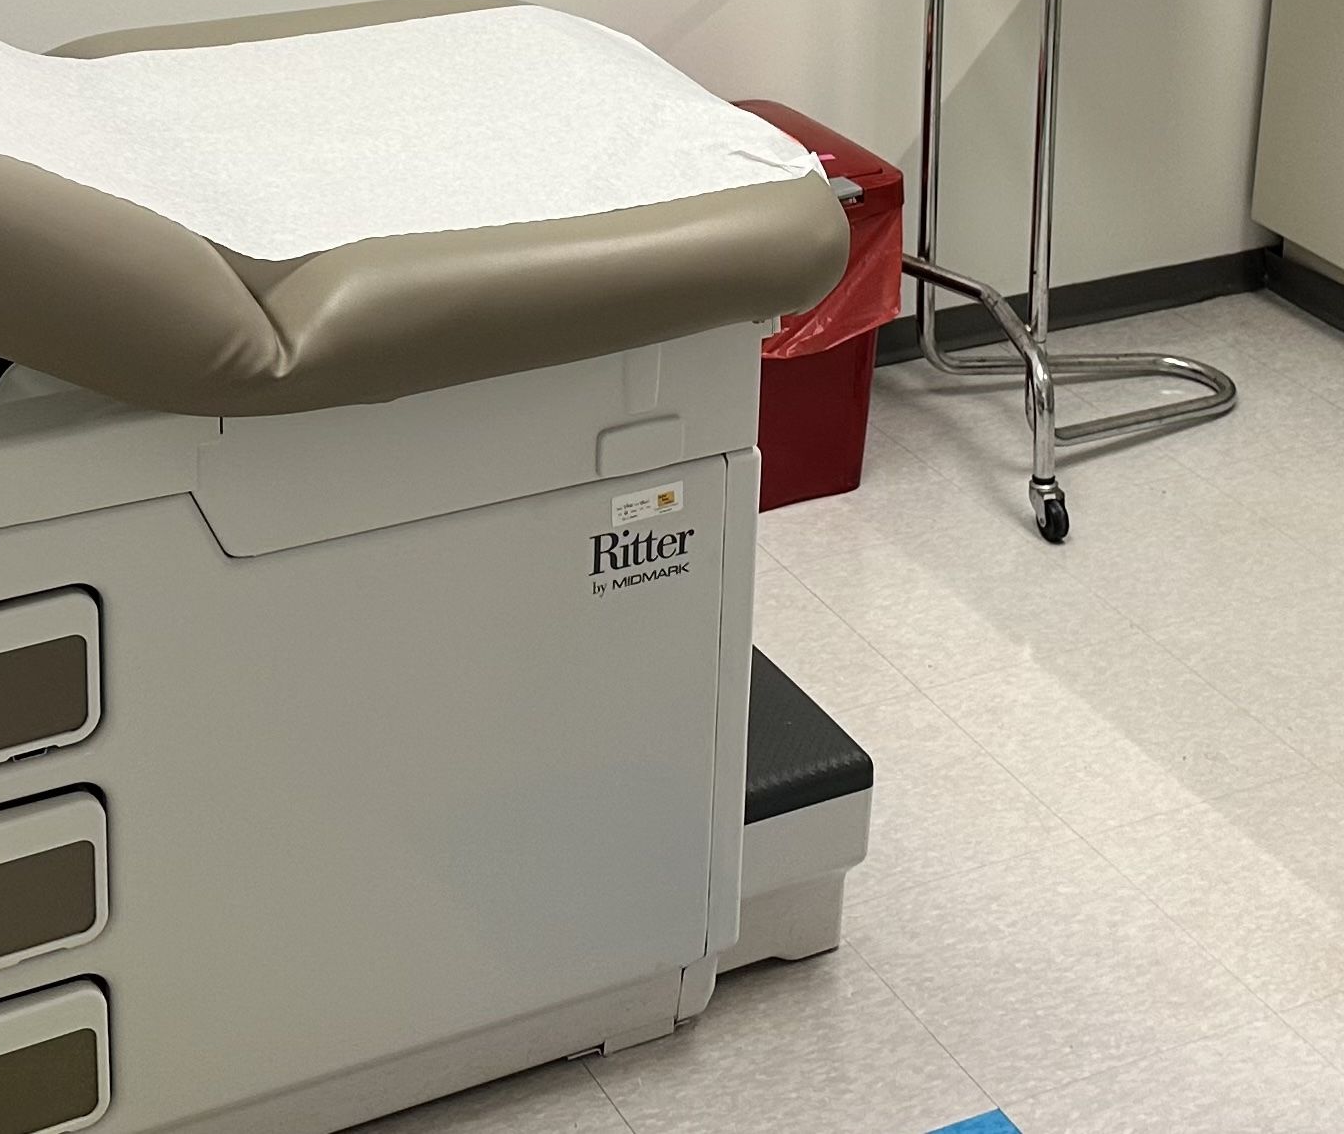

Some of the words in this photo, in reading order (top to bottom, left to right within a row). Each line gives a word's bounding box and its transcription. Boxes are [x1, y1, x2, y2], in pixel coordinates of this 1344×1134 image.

[588, 527, 695, 577] Ritter
[592, 581, 608, 598] by
[612, 562, 690, 591] MIDMARK
